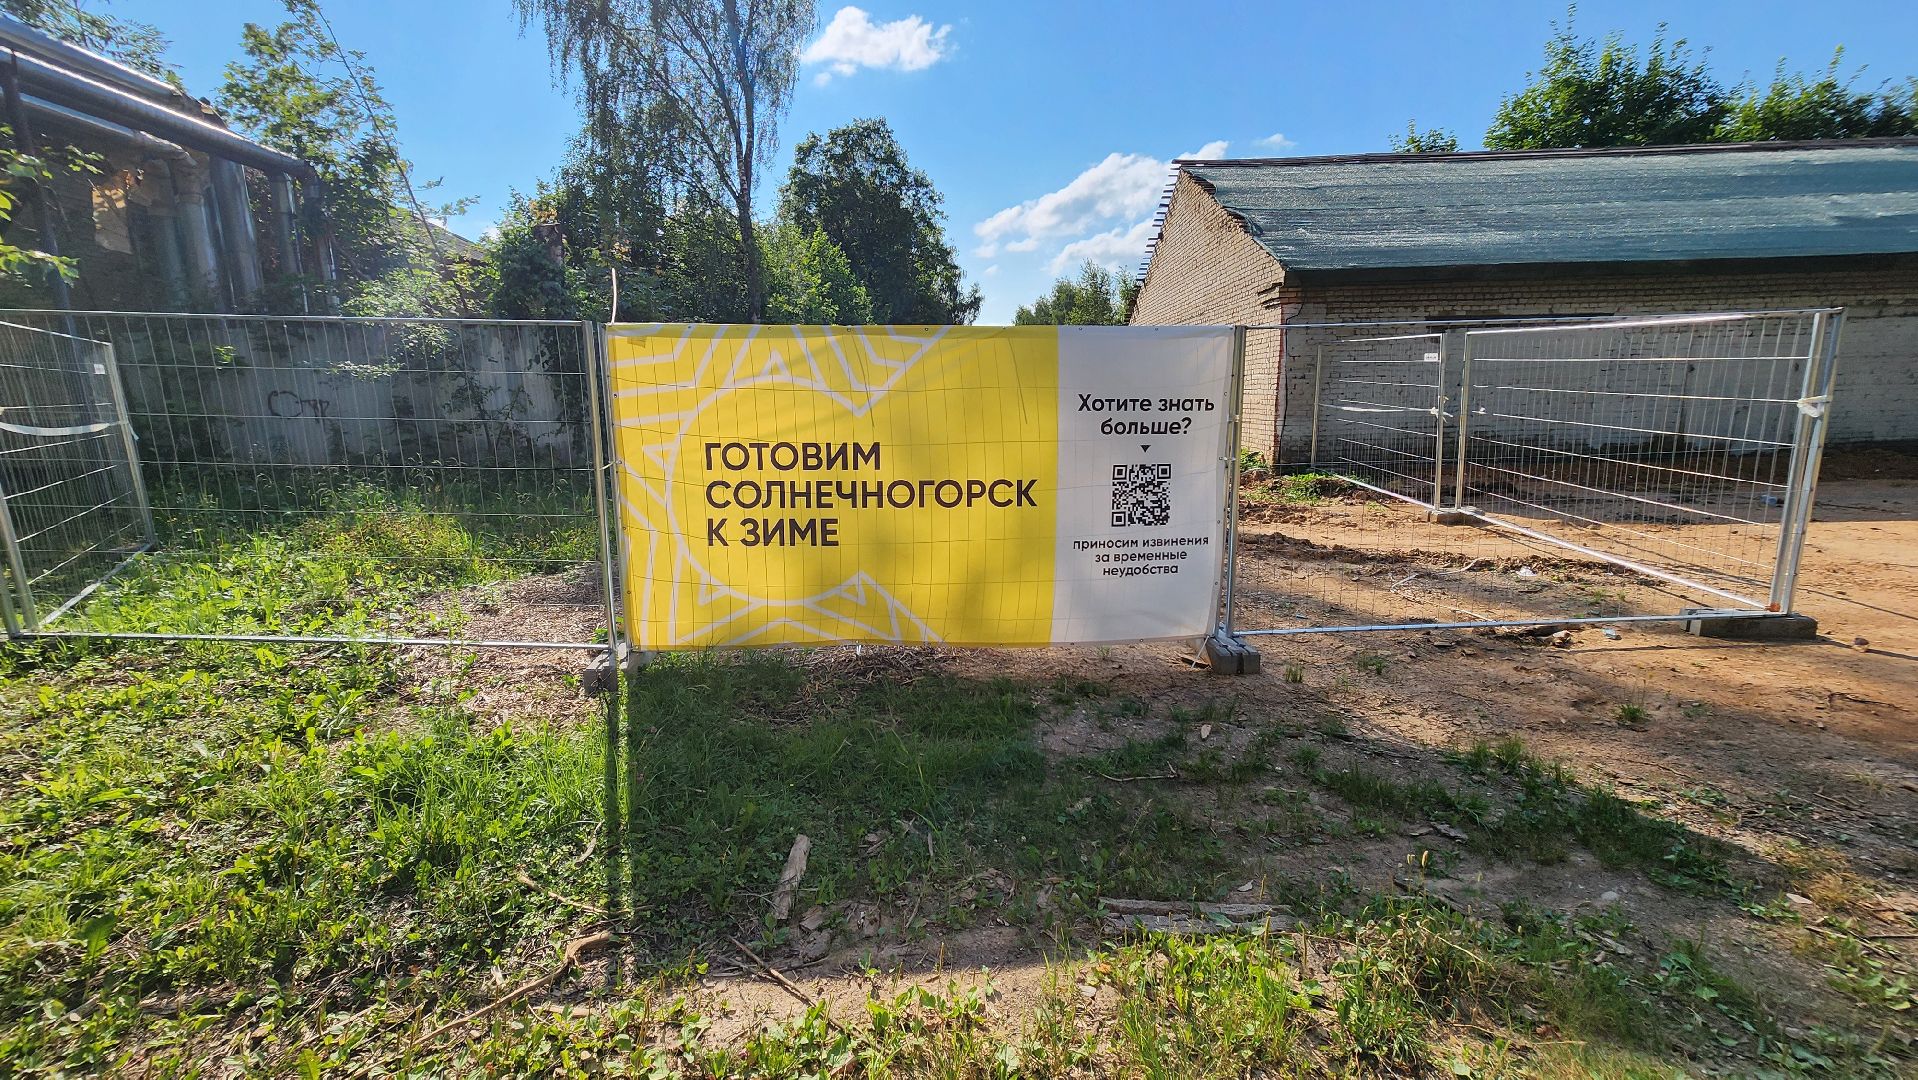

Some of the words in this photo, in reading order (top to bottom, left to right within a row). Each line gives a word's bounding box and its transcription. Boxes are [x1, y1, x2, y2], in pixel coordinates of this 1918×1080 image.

[1078, 393, 1152, 412] Хотите
[1158, 398, 1215, 412] знать
[1100, 417, 1192, 436] больше?
[705, 441, 881, 471] ГОТОВИМ
[705, 479, 1038, 509] СОЛНЕЧНОГОРСК
[707, 518, 729, 547] К
[739, 518, 840, 547] ЗИМЕ
[1073, 538, 1138, 550] приносим
[1142, 536, 1209, 547] извинения
[1094, 554, 1110, 563] за
[1113, 551, 1188, 564] временные
[1102, 565, 1179, 577] неудобства
